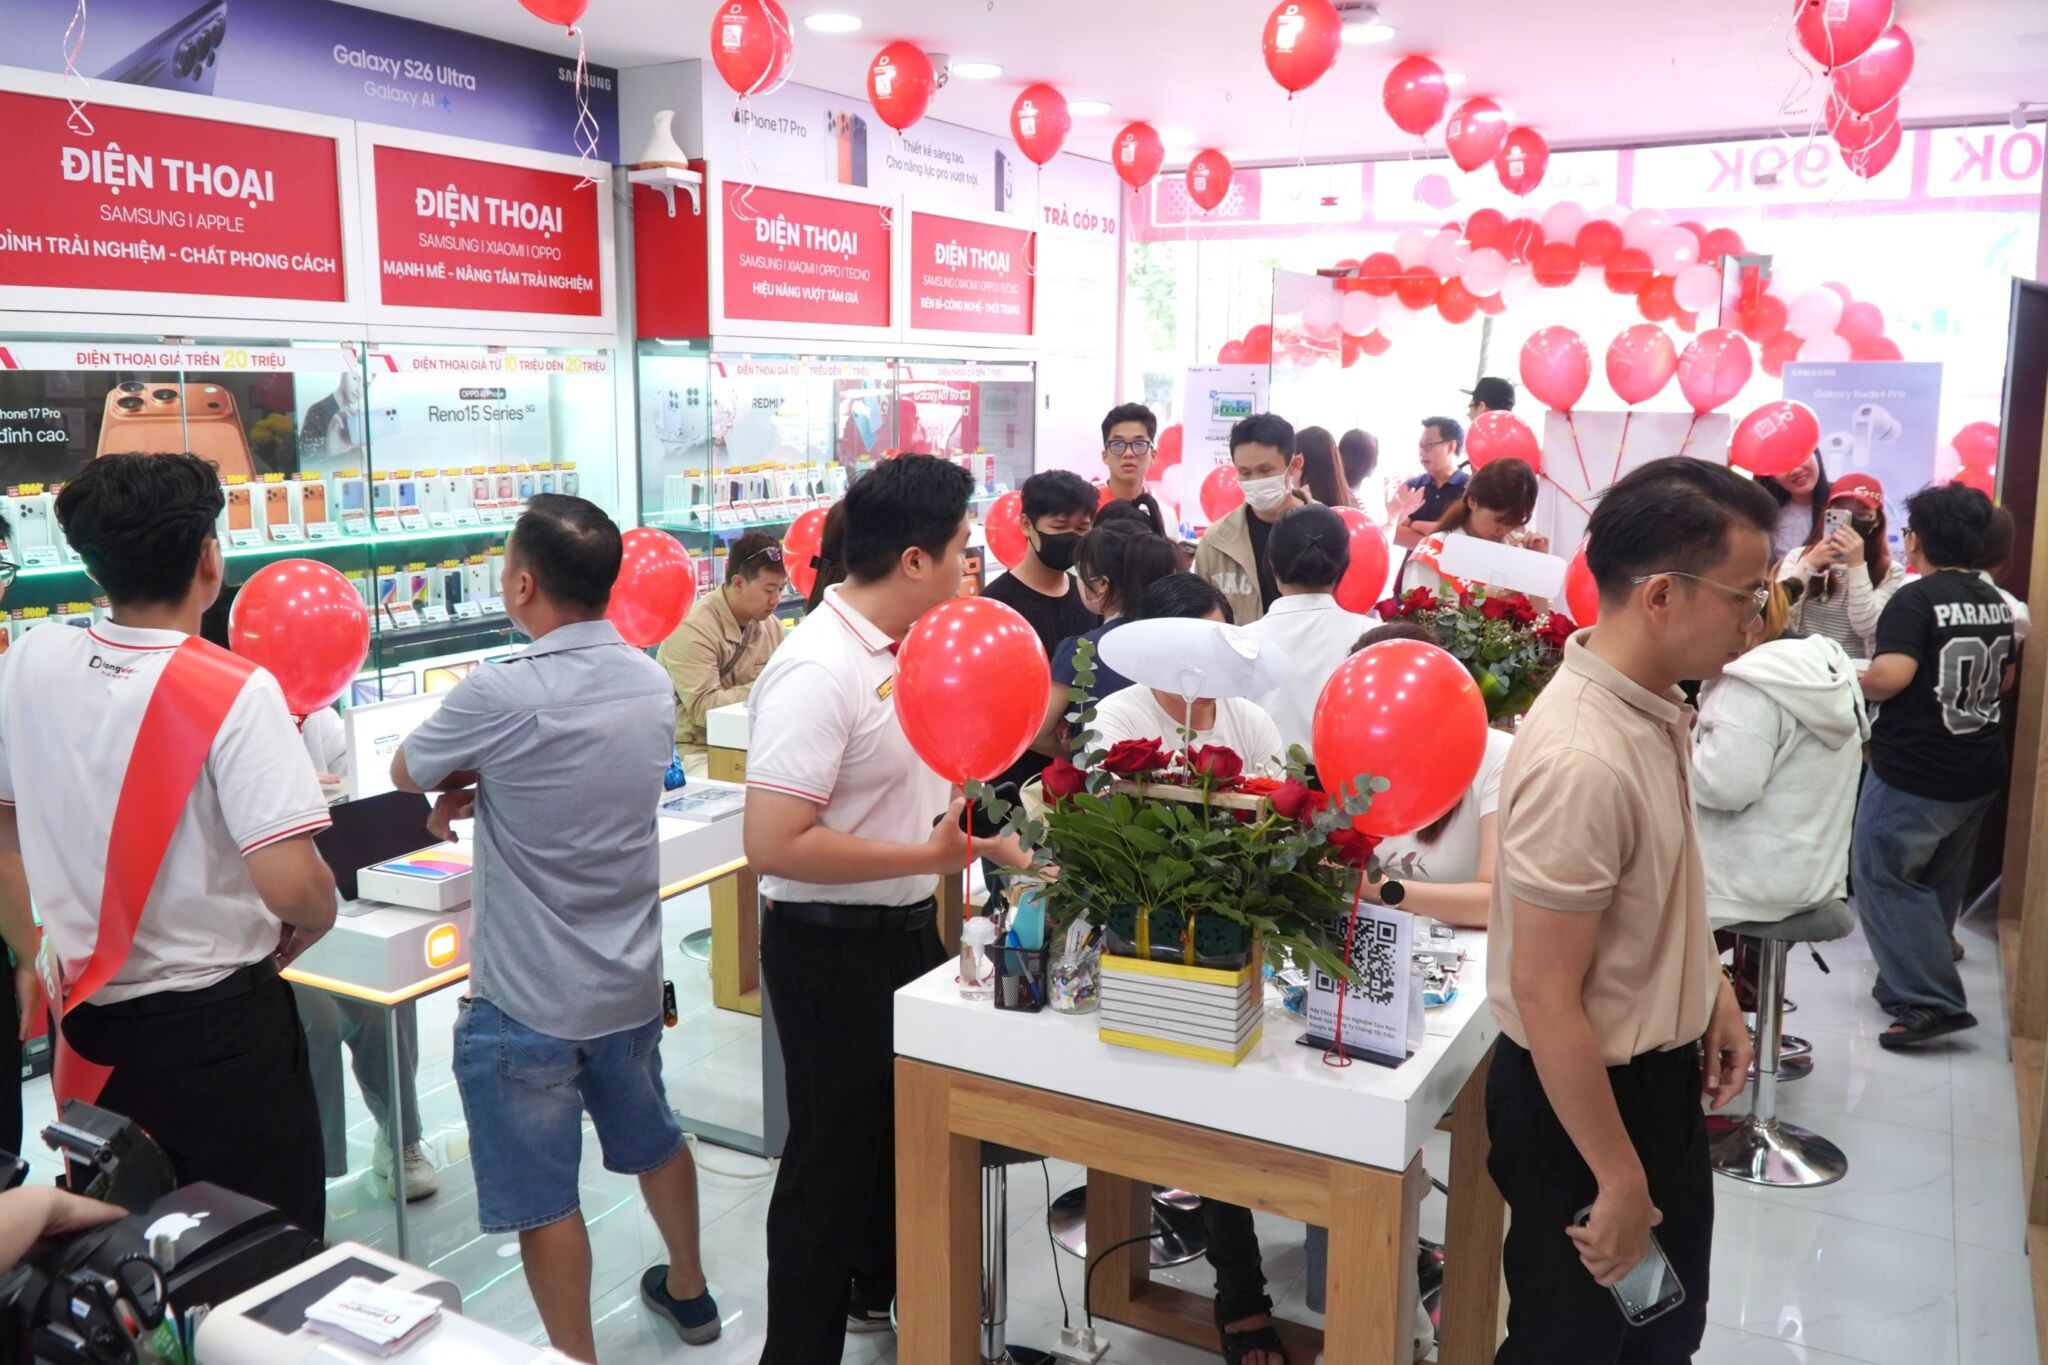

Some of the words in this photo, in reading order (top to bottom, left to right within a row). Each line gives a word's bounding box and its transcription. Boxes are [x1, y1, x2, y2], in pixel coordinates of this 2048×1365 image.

[333, 44, 400, 79] Galaxy
[404, 60, 434, 82] S26
[436, 65, 476, 91] Ultra
[558, 67, 611, 91] SAMSUNG
[364, 80, 418, 108] Galaxy
[421, 93, 435, 107] AI
[741, 110, 777, 131] iPhone
[778, 118, 788, 134] 17
[790, 121, 807, 138] Pro
[934, 147, 951, 163] sáng
[61, 142, 154, 195] ĐIỆN
[161, 157, 275, 208] THOẠI
[100, 204, 185, 228] SAMSUNG
[196, 213, 245, 233] APPLE
[415, 184, 479, 228] ĐIỆN
[484, 197, 563, 239] THOẠI
[1073, 208, 1098, 231] GÓP
[1102, 217, 1116, 235] 30
[419, 232, 480, 253] SAMSUNG
[486, 241, 525, 257] XIAOMI
[531, 245, 562, 261] OPPO
[755, 213, 800, 252] ĐIỆN
[803, 224, 858, 260] THOẠI
[45, 234, 90, 256] TRẢI
[93, 240, 165, 264] NGHIỆM
[180, 244, 226, 265] CHẤT
[230, 251, 289, 271] PHONG
[291, 252, 336, 273] CÁCH
[935, 239, 968, 272] ĐIỆN
[969, 247, 1011, 277] THOẠI
[384, 260, 424, 279] MẠNH
[427, 262, 446, 279] MẼ
[456, 264, 492, 283] NÂNG
[495, 268, 519, 286] TẦM
[522, 271, 547, 288] TRẢI
[549, 274, 593, 293] NGHIỆM
[739, 254, 783, 271] SAMSUNG
[787, 262, 815, 275] XIAOMI
[820, 265, 841, 277] OPPO
[845, 268, 871, 282] TECNO
[753, 280, 774, 297] HIỆU
[776, 282, 801, 299] NĂNG
[802, 286, 825, 303] VƯỢT
[845, 290, 859, 304] GIÁ
[76, 352, 111, 367] ĐIỆN
[114, 353, 157, 368] THOẠI
[159, 353, 181, 366] GIÁ
[186, 353, 220, 366] TRÊN
[223, 349, 249, 368] 20
[251, 354, 286, 367] TRIỆU
[413, 357, 437, 371] ĐIỆN
[439, 359, 469, 371] THOẠI
[471, 359, 488, 371] GIÁ
[489, 358, 503, 371] TỪ
[519, 359, 544, 371] TRIỆU
[546, 358, 564, 371] ĐẾN
[566, 356, 582, 372] 20
[583, 360, 606, 372] TRIỆU
[461, 389, 479, 398] OPPO
[752, 398, 779, 409] REDMI
[1814, 389, 1851, 399] Galaxy
[1887, 390, 1906, 398] Pro
[28, 408, 40, 419] 17
[42, 408, 61, 419] Pro
[429, 405, 480, 422] Reno15
[483, 404, 524, 421] Series
[525, 404, 535, 413] 5G
[36, 429, 70, 442] cao.
